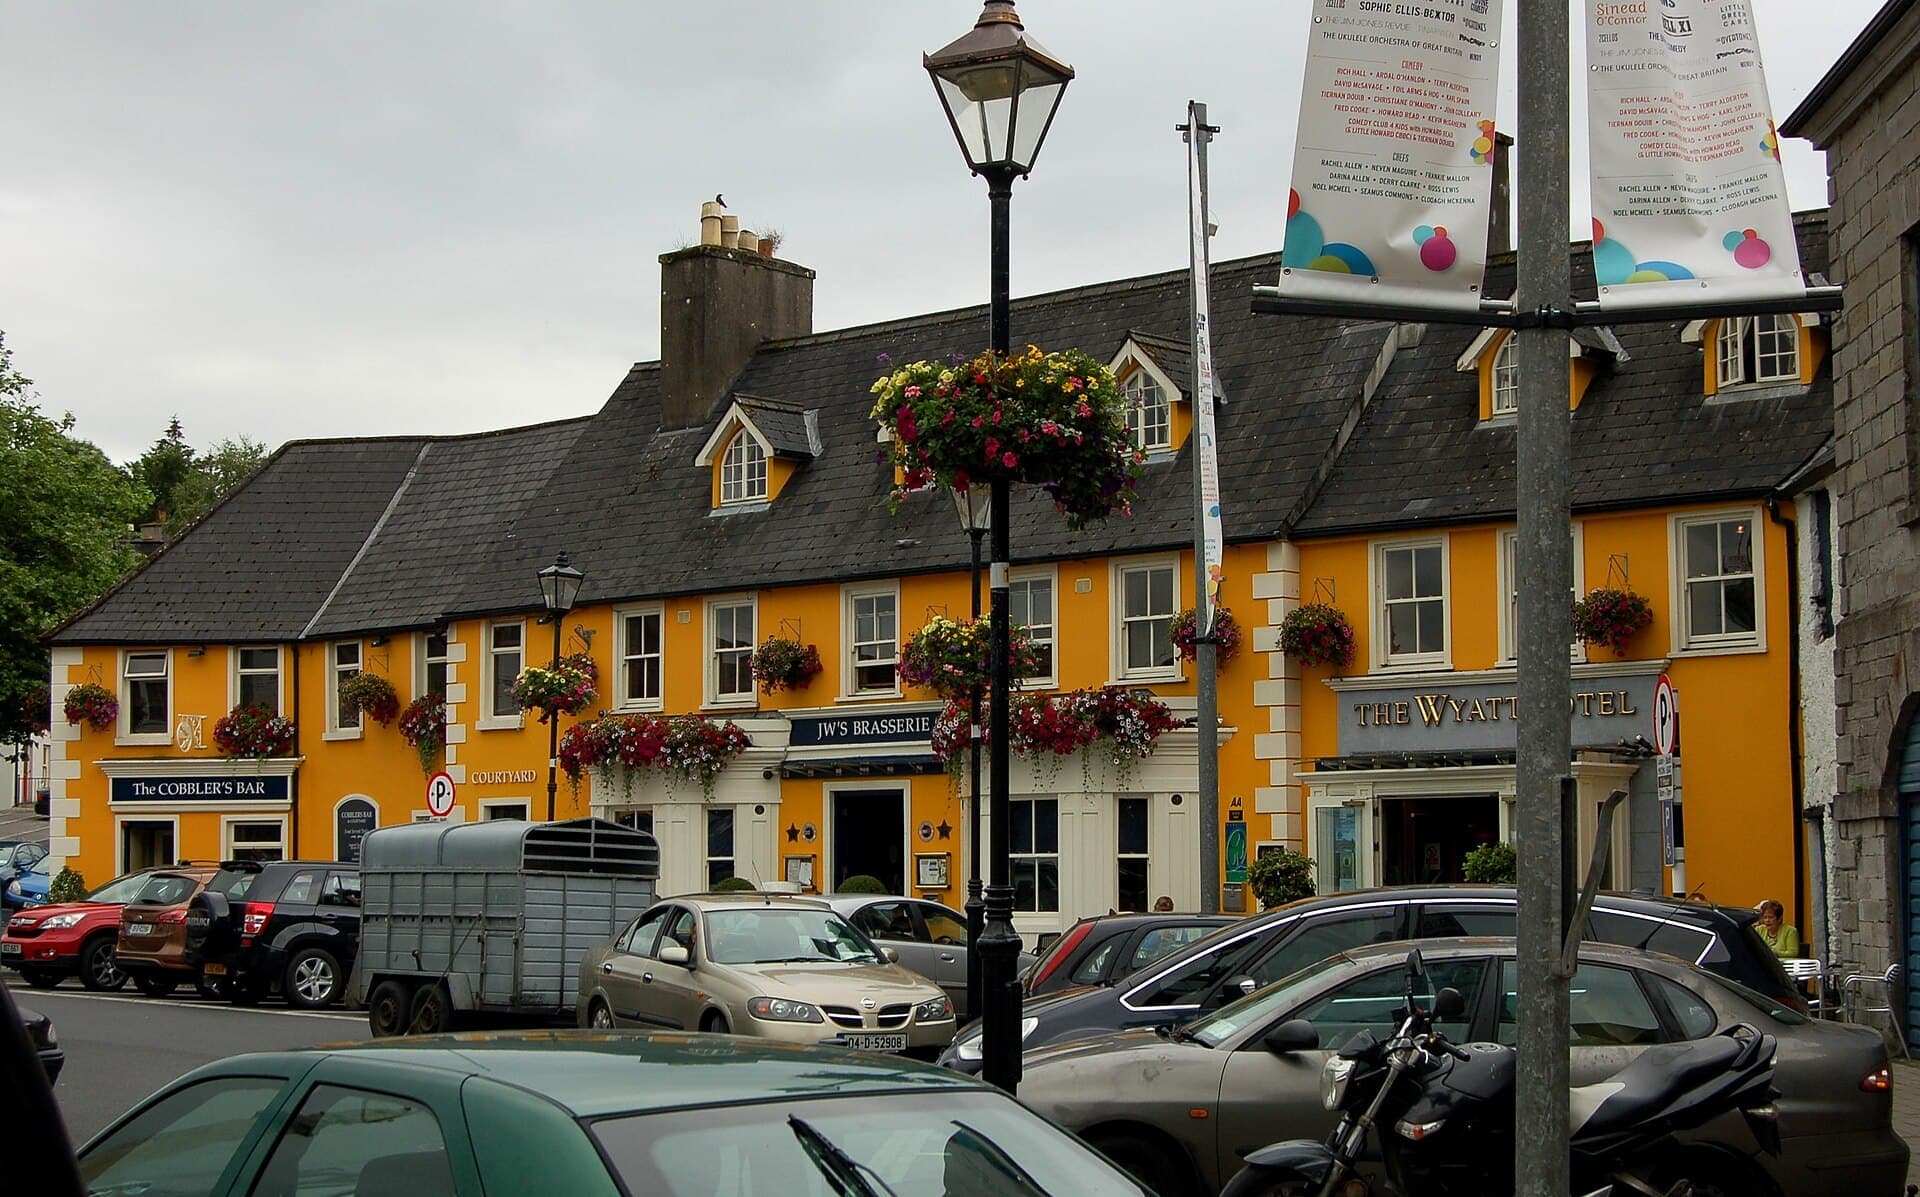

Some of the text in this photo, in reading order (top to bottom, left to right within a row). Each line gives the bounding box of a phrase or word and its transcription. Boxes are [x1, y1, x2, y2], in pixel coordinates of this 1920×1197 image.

[1359, 1, 1392, 13] SOPHIE
[1596, 0, 1647, 16] Sinead
[1596, 16, 1648, 26] O'Connor
[1323, 31, 1336, 40] THE
[1337, 32, 1368, 42] UKULELE
[1369, 36, 1410, 47] ORCHESTRA
[1412, 40, 1420, 48] OF
[1422, 42, 1442, 52] GREAT
[1336, 67, 1351, 75] RICH
[1352, 69, 1367, 77] HALL
[1376, 71, 1395, 80] ARDAL
[1601, 64, 1614, 72] THE
[1615, 63, 1645, 72] UKULELE
[1700, 66, 1728, 79] BRITAIN
[1334, 79, 1352, 87] DAVID
[1428, 90, 1440, 98] HOG
[1373, 96, 1407, 106] CHRISTIANE
[1699, 100, 1717, 110] TERRY
[1718, 92, 1749, 105] ALDERTON
[1734, 103, 1752, 112] SPAIN
[1334, 104, 1349, 112] FRED
[1378, 109, 1403, 118] HOWARD
[1404, 111, 1420, 120] READ
[1348, 118, 1371, 127] COMEDY
[1372, 120, 1388, 128] CLUB
[1395, 123, 1408, 131] KIDS
[1608, 120, 1633, 128] TIERNAN
[1720, 118, 1736, 128] JOHN
[1352, 127, 1370, 135] LITTLE
[1370, 129, 1394, 138] HOWARD
[1623, 131, 1639, 139] FRED
[1704, 133, 1721, 142] KEVIN
[1701, 143, 1725, 154] HOWARD
[1725, 139, 1741, 147] READ
[1321, 159, 1343, 168] RACHEL
[1344, 161, 1362, 170] ALLEN
[1351, 174, 1370, 183] ALLEN
[1379, 177, 1398, 186] DERRY
[1399, 180, 1421, 189] CLARKE
[1442, 186, 1460, 194] LEWIS
[1618, 185, 1641, 193] RACHEL
[1642, 185, 1661, 193] ALLEN
[1718, 179, 1743, 191] FRANKIE
[1743, 173, 1768, 183] MALLON
[1312, 183, 1327, 191] NOEL
[1360, 188, 1384, 197] SEAMUS
[1384, 190, 1413, 200] COMMONS
[1652, 196, 1671, 204] ALLEN
[1726, 191, 1742, 200] ROSS
[1742, 186, 1760, 196] LEWIS
[1613, 209, 1628, 217] NOEL
[1662, 208, 1686, 216] SEAMUS
[1354, 691, 1637, 727] THE WYATT TEL
[817, 717, 930, 740] JW'S BRASSERIE
[471, 769, 537, 784] COURTYARD
[133, 781, 265, 795] The COBBLER'S BAR
[436, 781, 446, 809] P
[1231, 797, 1242, 807] AA
[848, 1037, 903, 1049] 04-D-52908
